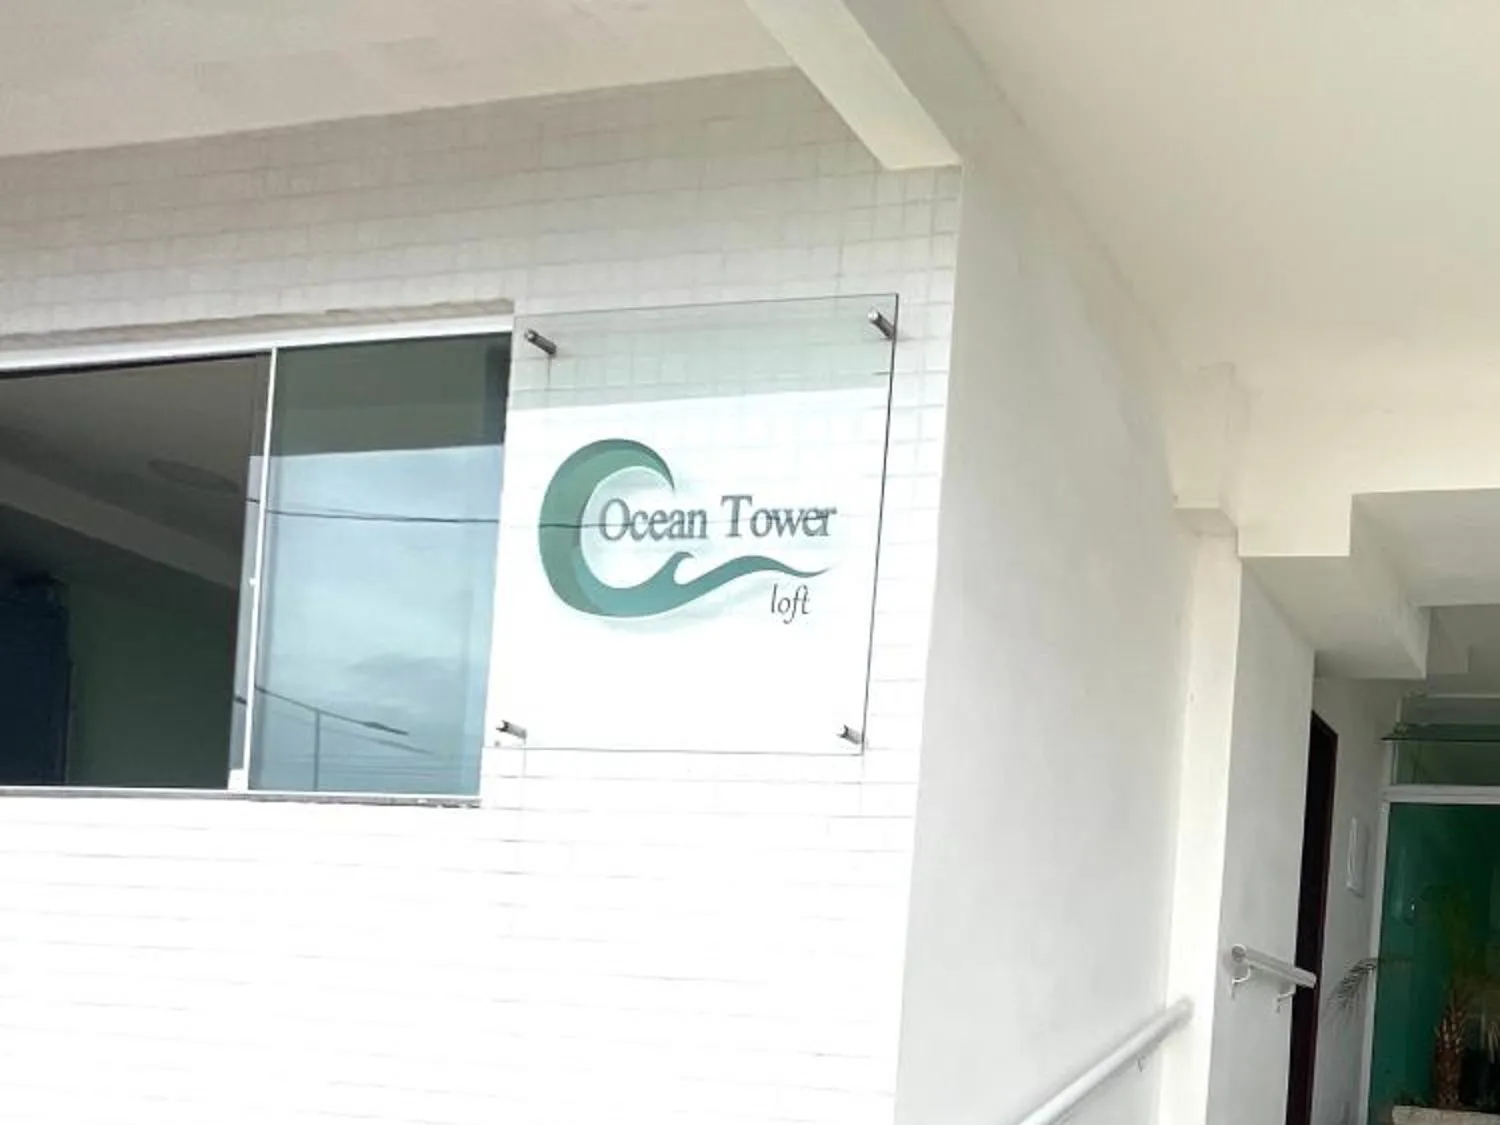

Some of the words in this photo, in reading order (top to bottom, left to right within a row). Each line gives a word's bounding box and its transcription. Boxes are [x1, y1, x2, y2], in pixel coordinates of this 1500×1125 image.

[600, 498, 708, 541] Ocean
[720, 494, 838, 539] Tower
[770, 583, 810, 625] loft
